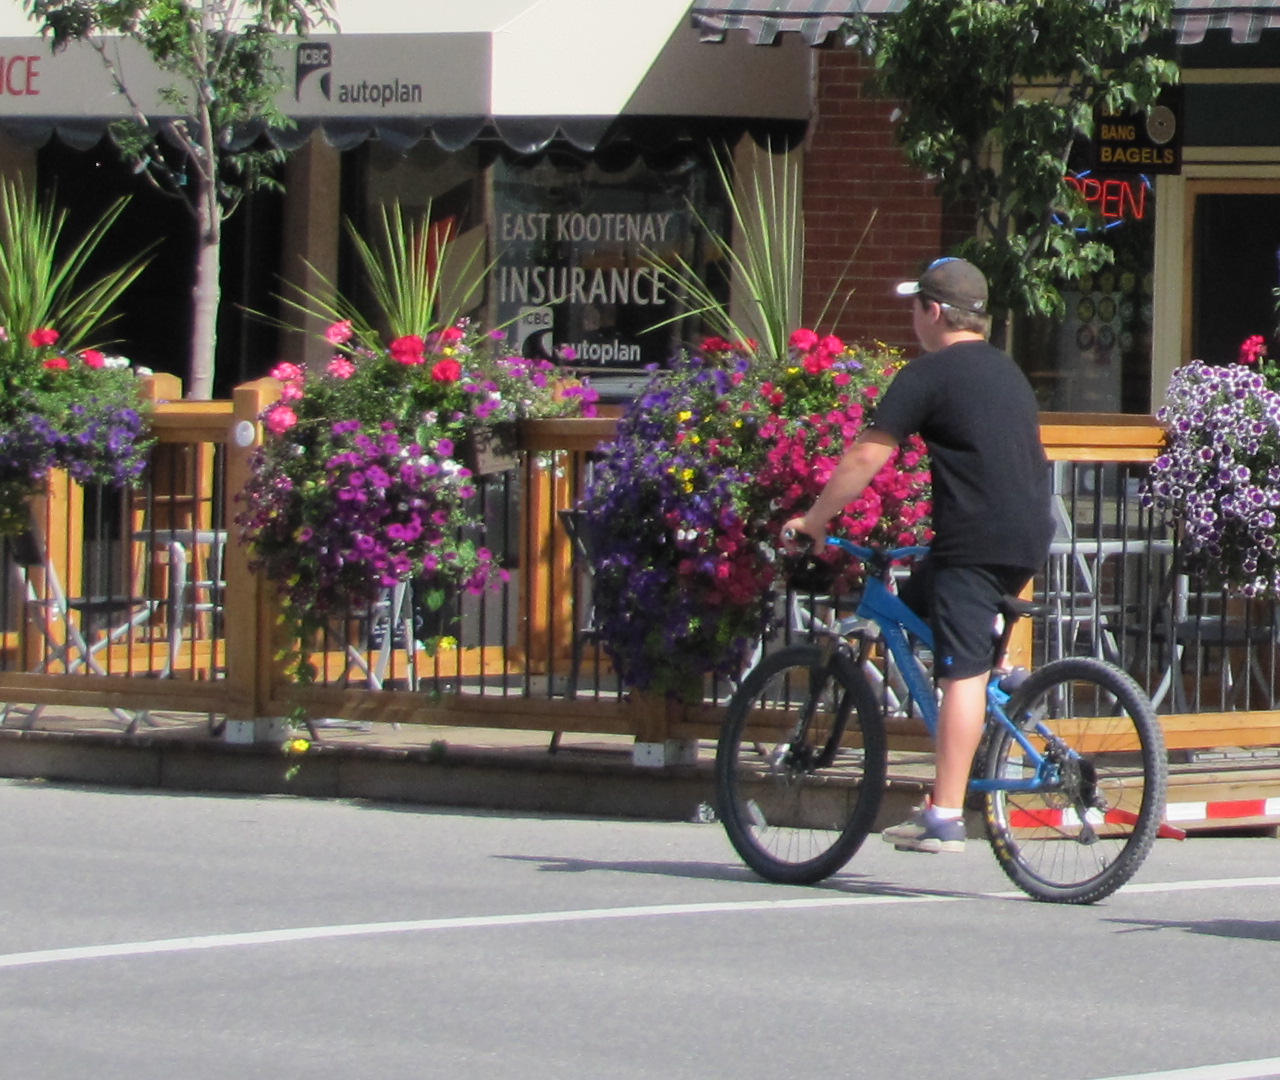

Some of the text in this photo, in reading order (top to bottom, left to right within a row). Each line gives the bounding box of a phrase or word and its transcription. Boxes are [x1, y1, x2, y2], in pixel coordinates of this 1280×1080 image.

[299, 48, 329, 65] ICBC
[338, 77, 422, 107] autoplan
[1101, 124, 1136, 141] BANG
[1101, 147, 1175, 164] BAGELS
[501, 212, 671, 242] EAST KOOTENAY
[500, 265, 666, 306] INSURANCE
